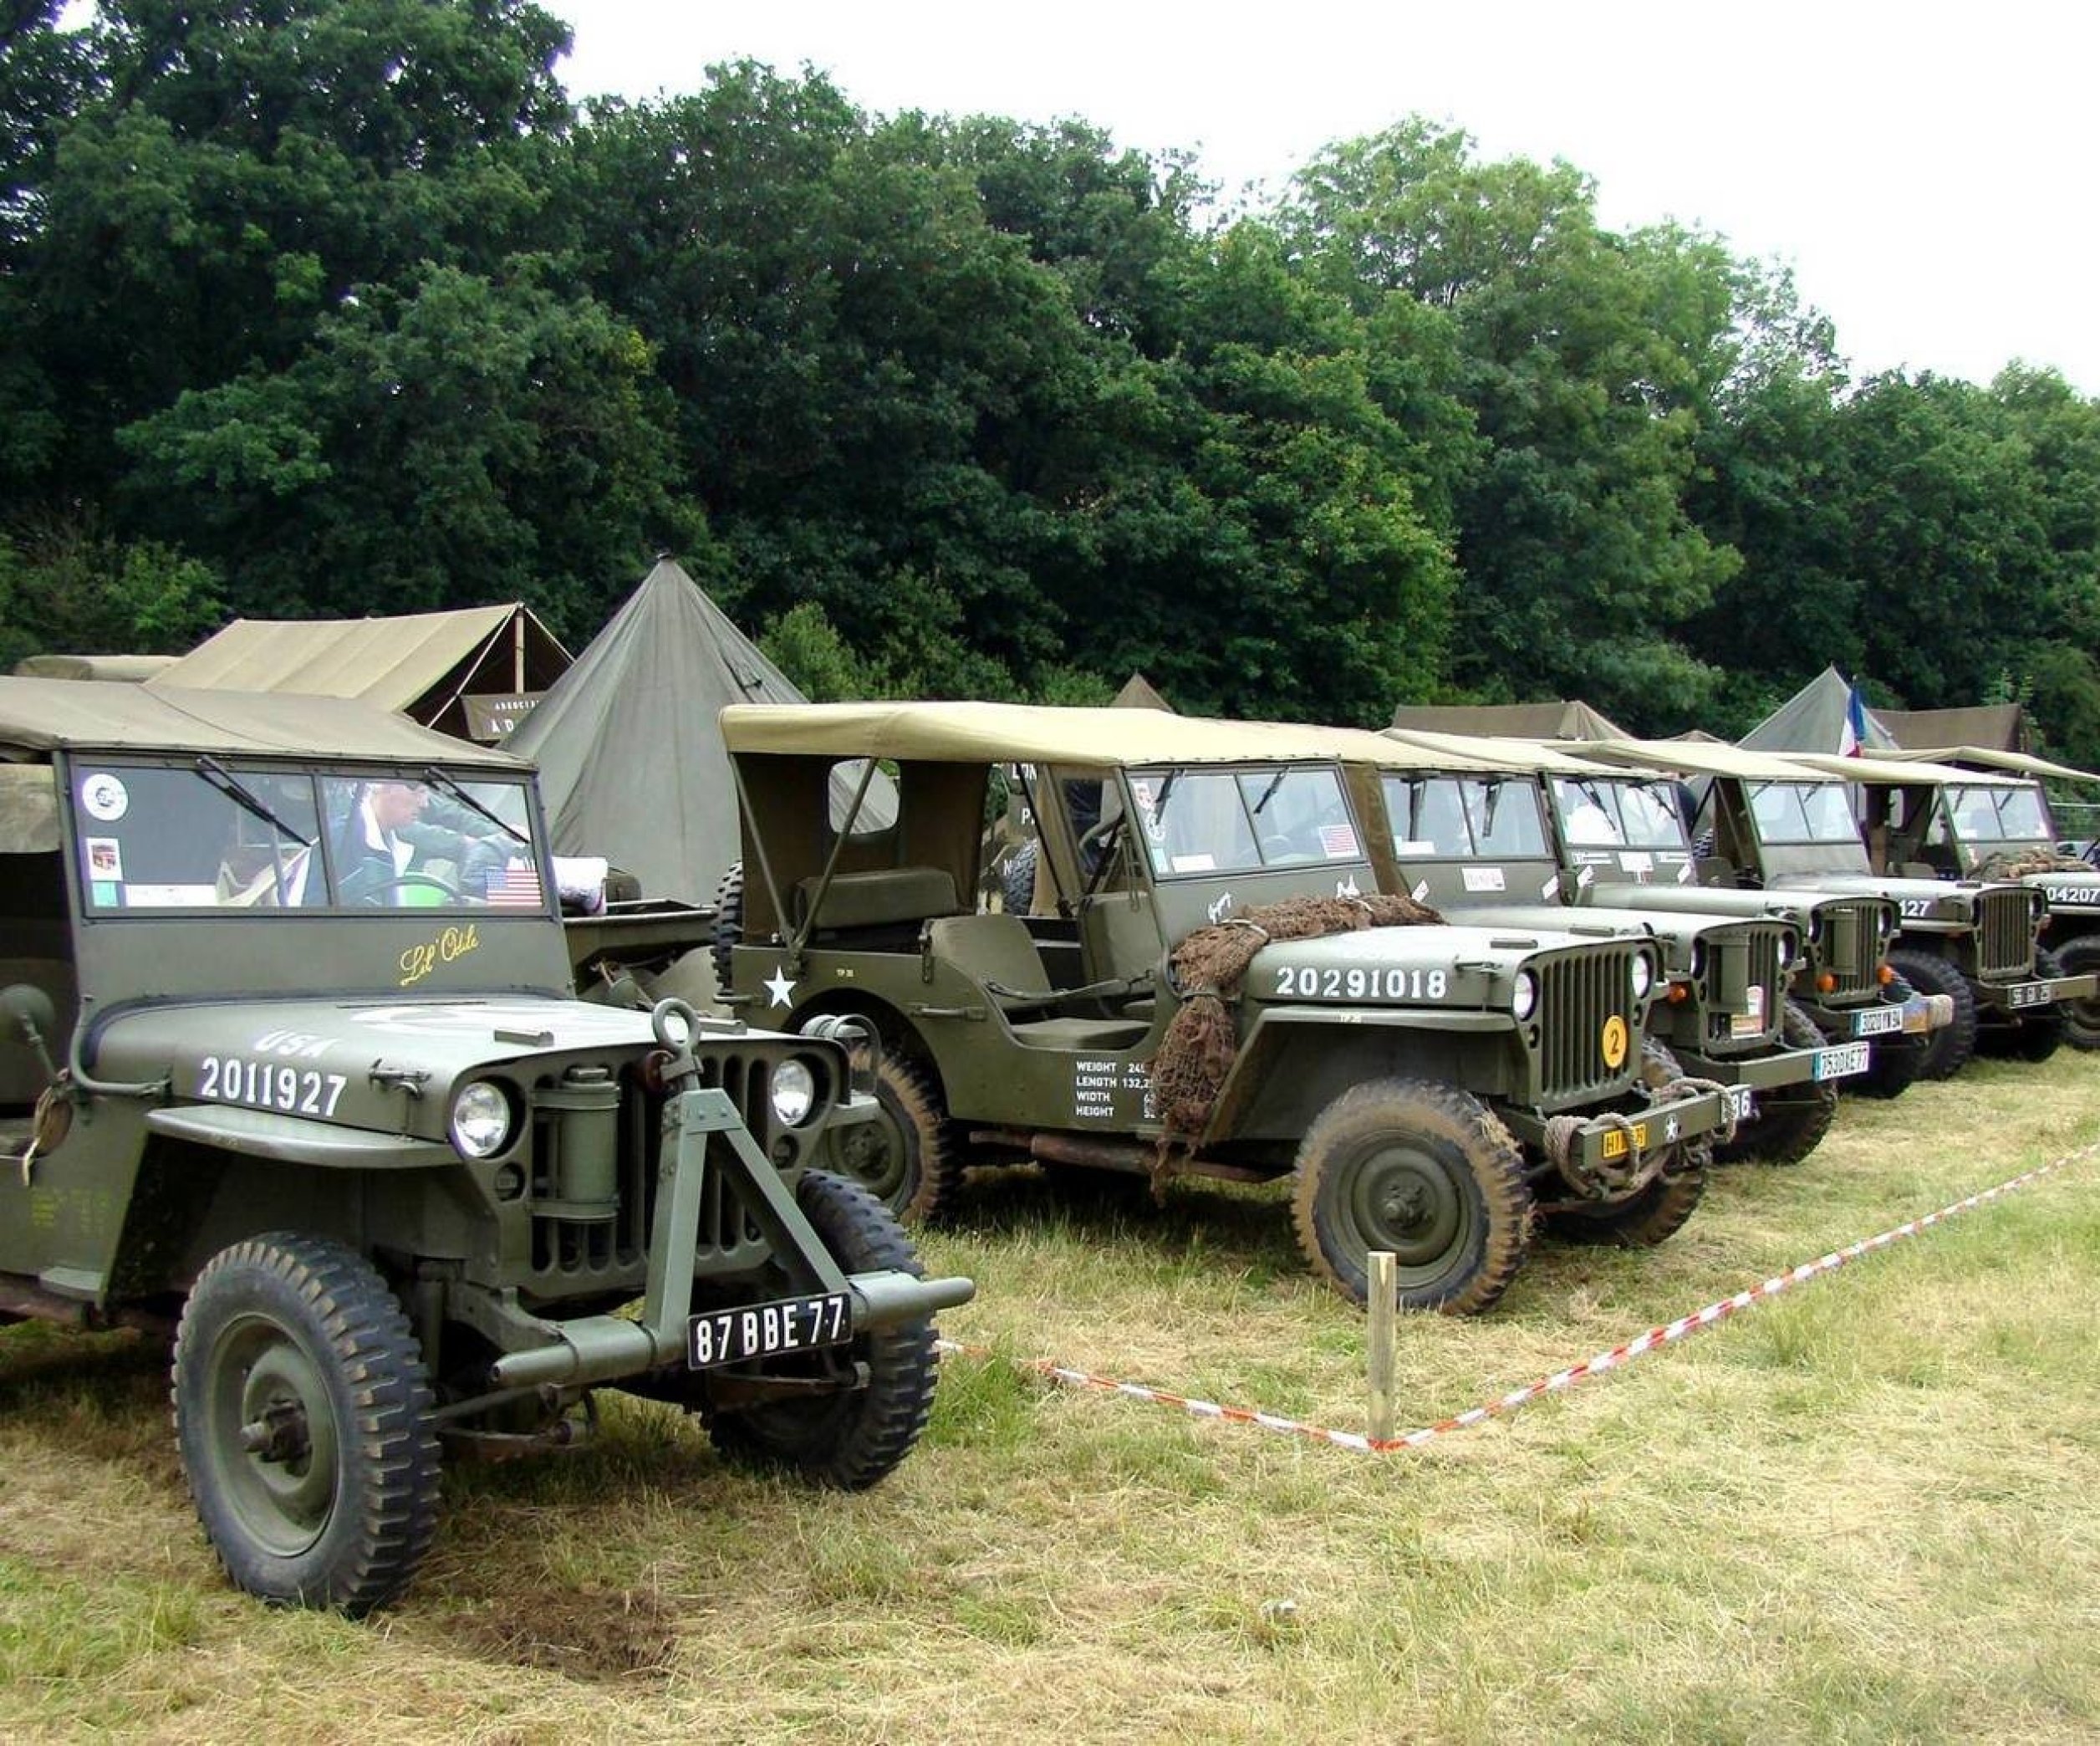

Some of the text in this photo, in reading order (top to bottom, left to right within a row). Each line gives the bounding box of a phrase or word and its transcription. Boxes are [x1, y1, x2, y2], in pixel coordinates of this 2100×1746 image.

[1276, 966, 1446, 999] 20291018
[1609, 1029, 1620, 1055] 2
[1075, 1060, 1117, 1074] WEIGHT
[201, 1056, 348, 1118] 2011927
[1075, 1075, 1118, 1088] LENGTH
[1075, 1090, 1111, 1102] WIDTH
[1075, 1105, 1114, 1118] HEIGHT
[696, 1296, 844, 1363] 87 BBE 77
